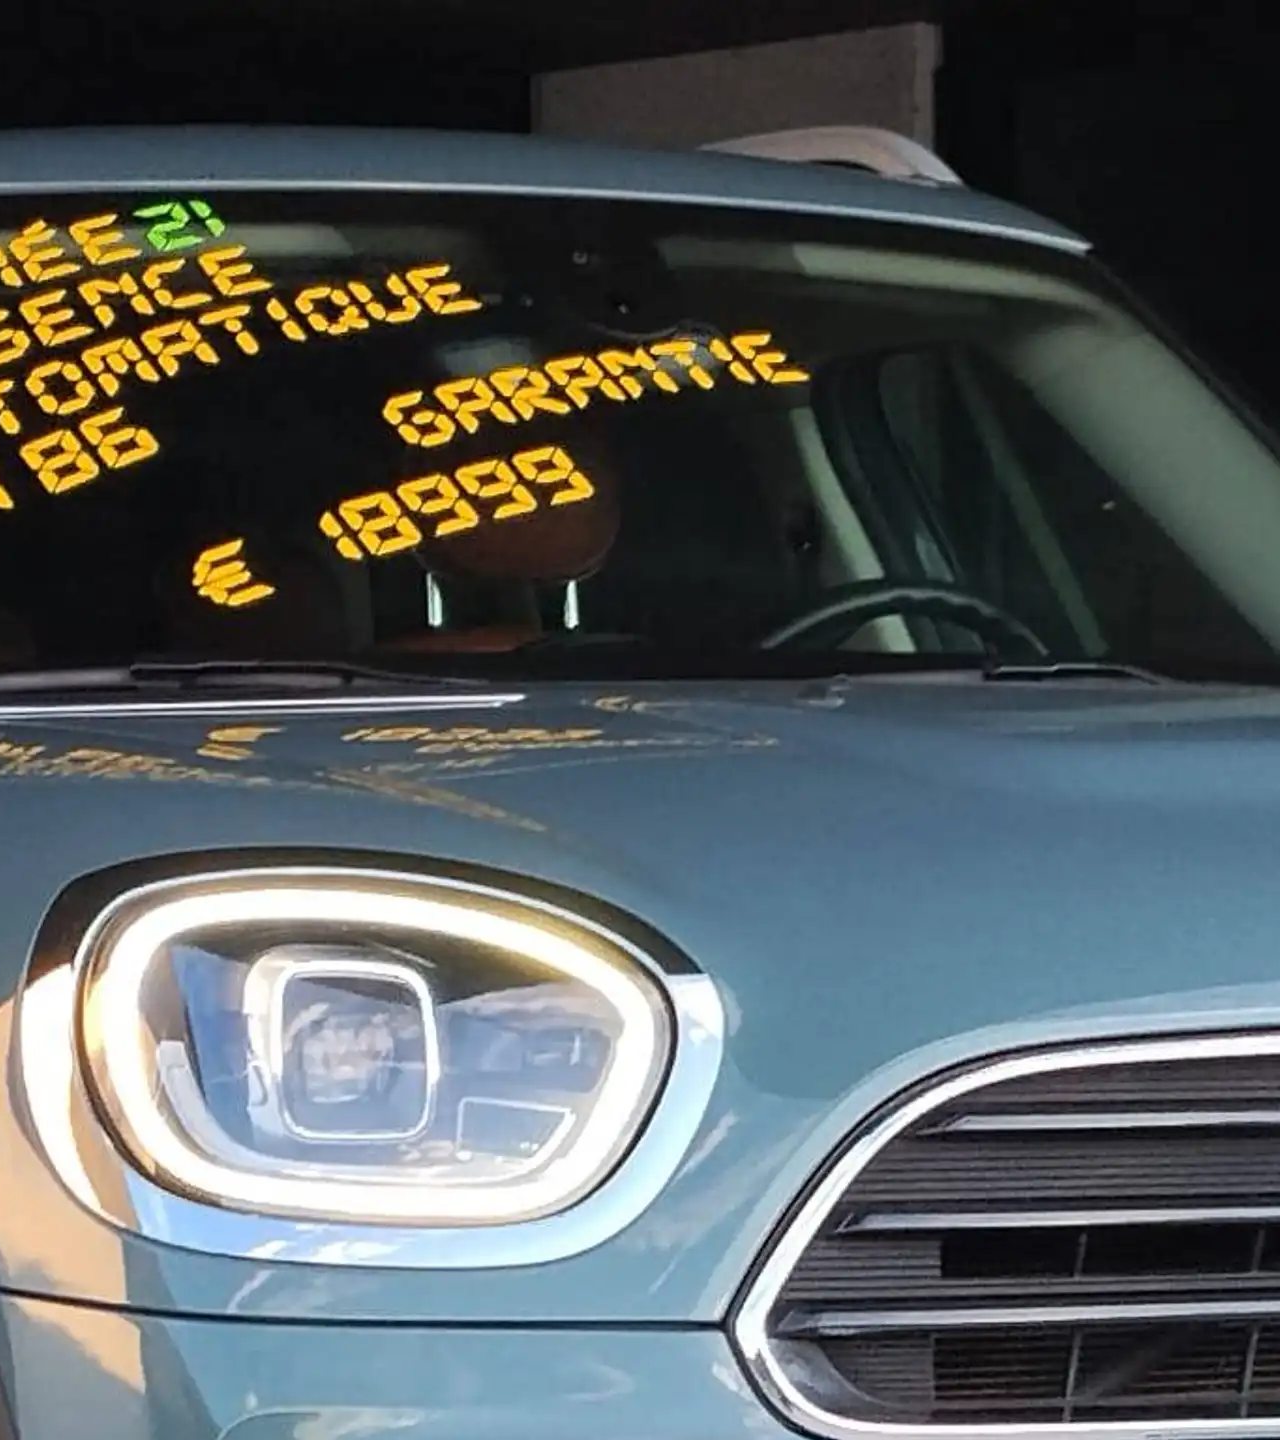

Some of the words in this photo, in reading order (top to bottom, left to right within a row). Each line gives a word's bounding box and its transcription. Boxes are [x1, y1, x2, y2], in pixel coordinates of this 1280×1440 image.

[132, 200, 226, 252] 21
[382, 332, 810, 448] GARANTIE
[19, 406, 160, 494] 86
[319, 445, 595, 561] 18999
